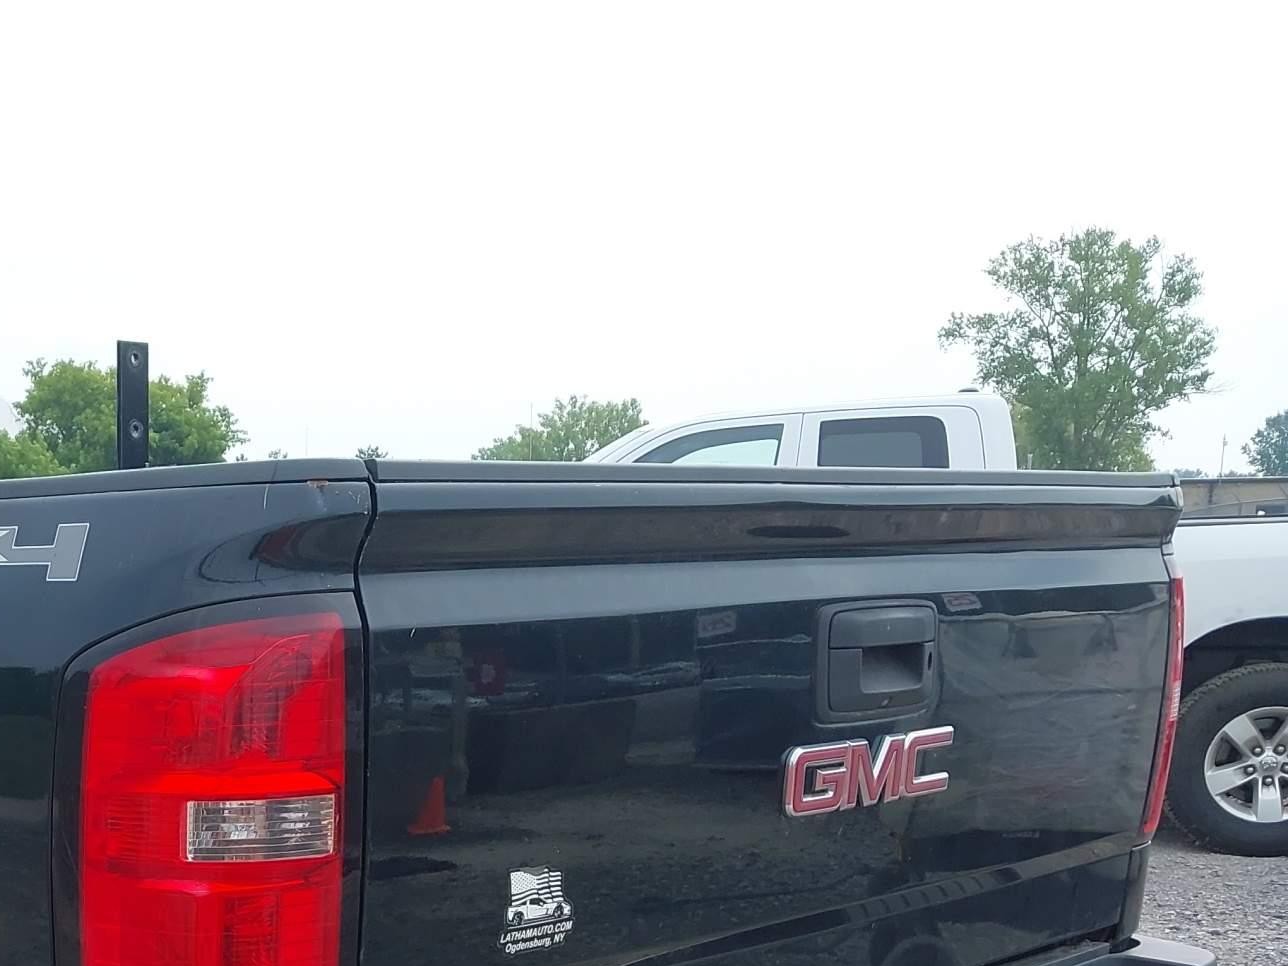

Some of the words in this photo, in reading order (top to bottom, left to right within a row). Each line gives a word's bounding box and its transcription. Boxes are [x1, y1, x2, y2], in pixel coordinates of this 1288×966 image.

[783, 725, 955, 817] GMC
[500, 920, 573, 943] LATHAMAUTO.COM
[505, 936, 553, 954] Ogdensburg,
[553, 932, 566, 943] NY
